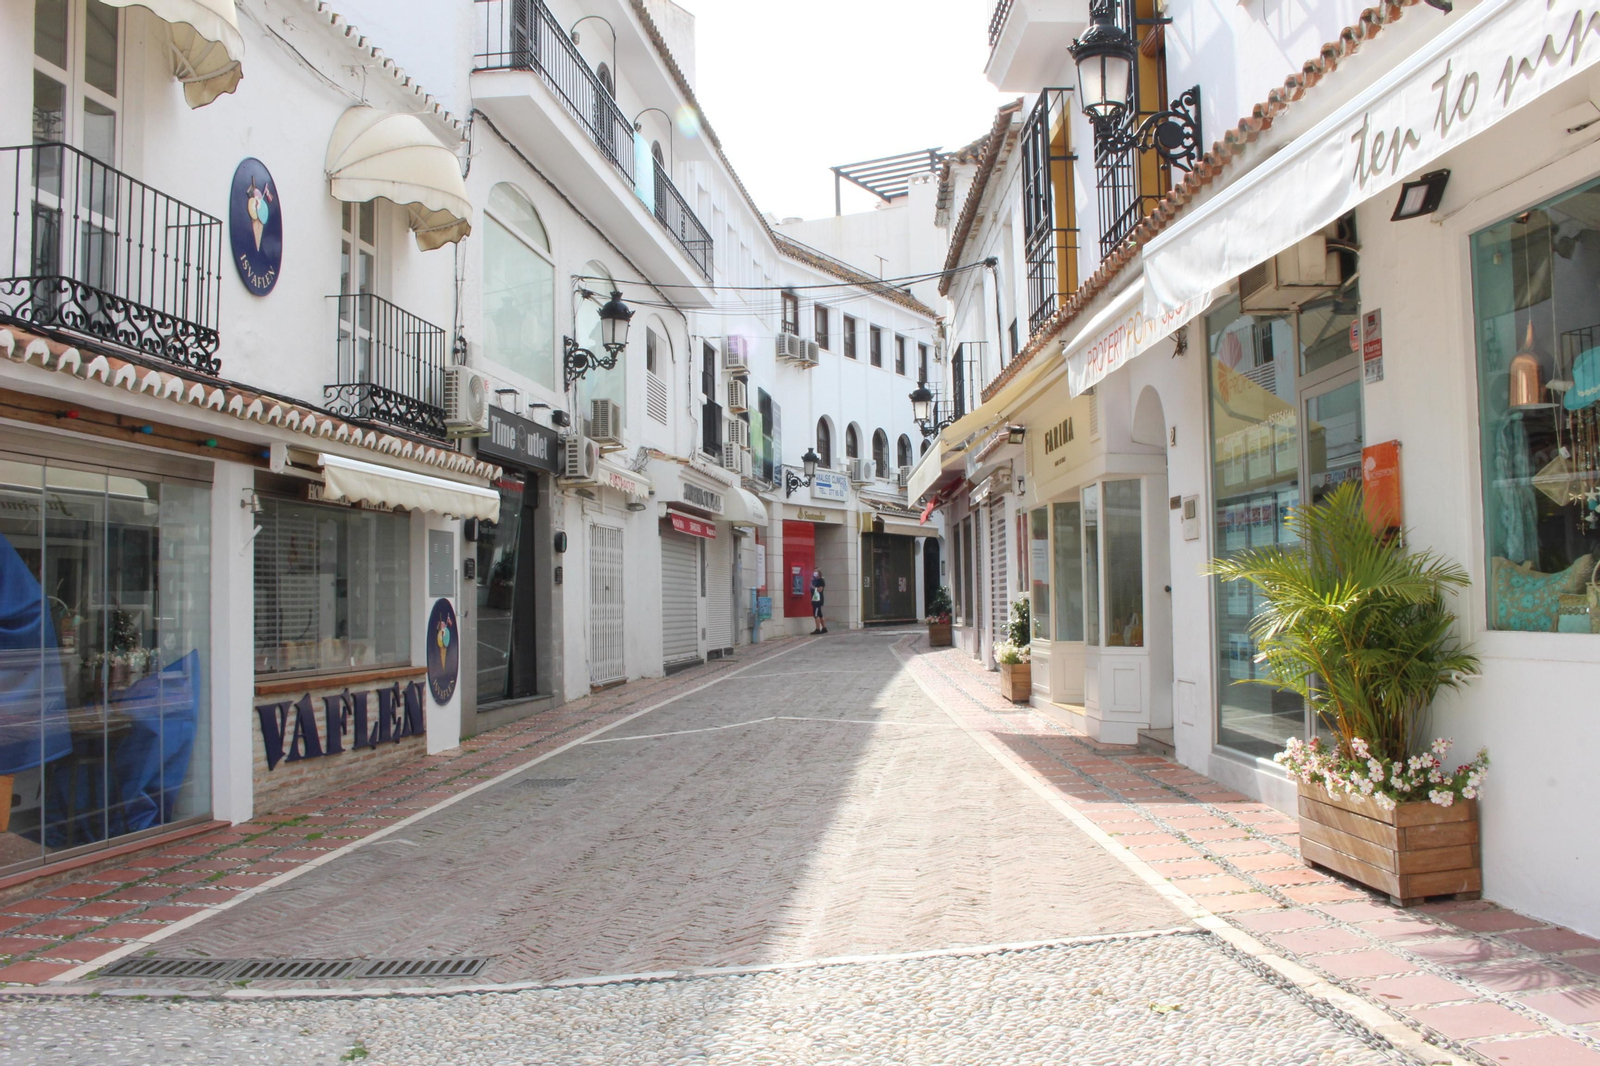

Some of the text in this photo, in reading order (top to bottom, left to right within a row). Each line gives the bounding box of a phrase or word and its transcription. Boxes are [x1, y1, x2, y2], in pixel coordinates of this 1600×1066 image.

[1351, 112, 1421, 191] ten
[1431, 58, 1480, 140] to
[240, 254, 276, 289] ISVAFLEN
[491, 415, 516, 450] Time
[1045, 416, 1074, 455] FARINA
[255, 680, 427, 771] VAFLEN
